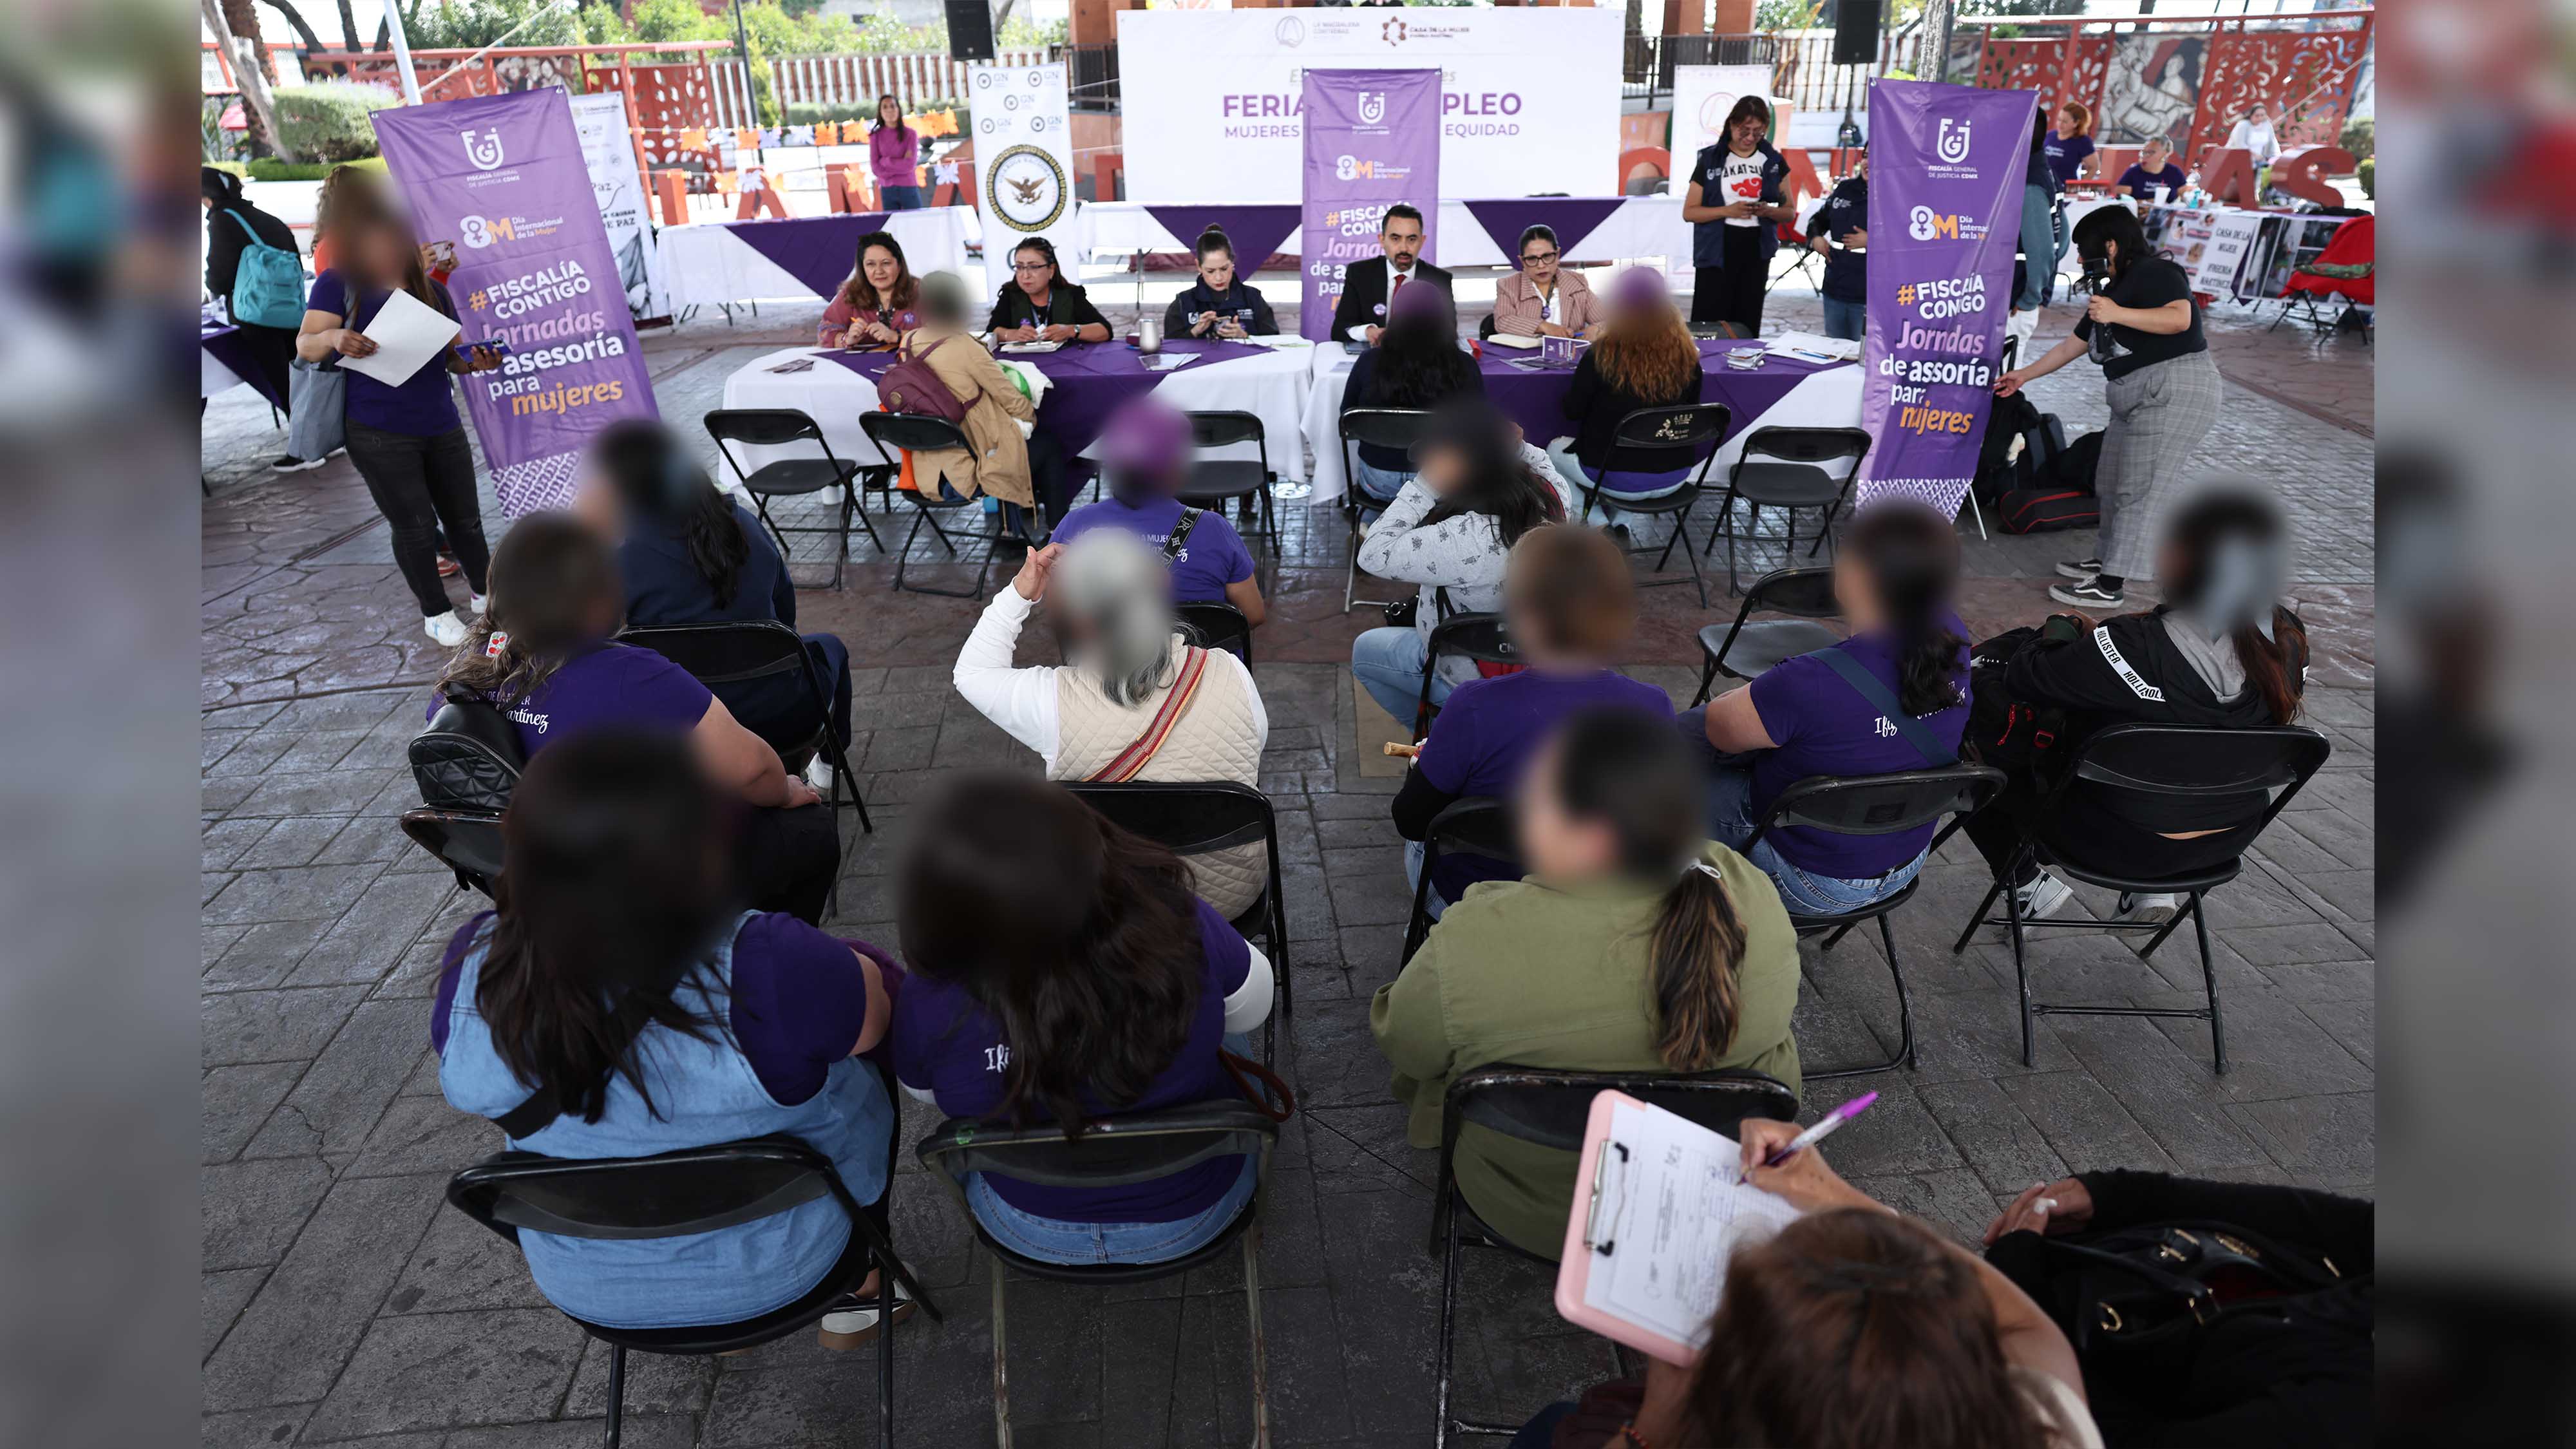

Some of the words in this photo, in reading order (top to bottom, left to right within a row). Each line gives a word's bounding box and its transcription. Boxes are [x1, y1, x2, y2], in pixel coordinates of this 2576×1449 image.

[1443, 93, 1521, 115] PLEO
[1226, 125, 1300, 138] MUJERES
[1445, 124, 1520, 138] EQUIDAD
[512, 216, 526, 225] Día
[514, 216, 564, 231] Internacional
[535, 227, 556, 236] Mujer
[1310, 260, 1331, 276] de
[495, 276, 591, 319] CONTIGO
[502, 332, 624, 375] asesoría
[1880, 354, 1907, 376] de
[488, 375, 540, 401] para
[512, 380, 623, 415] mujeres
[2096, 630, 2121, 664] HOLLISTER
[506, 708, 549, 734] artínez
